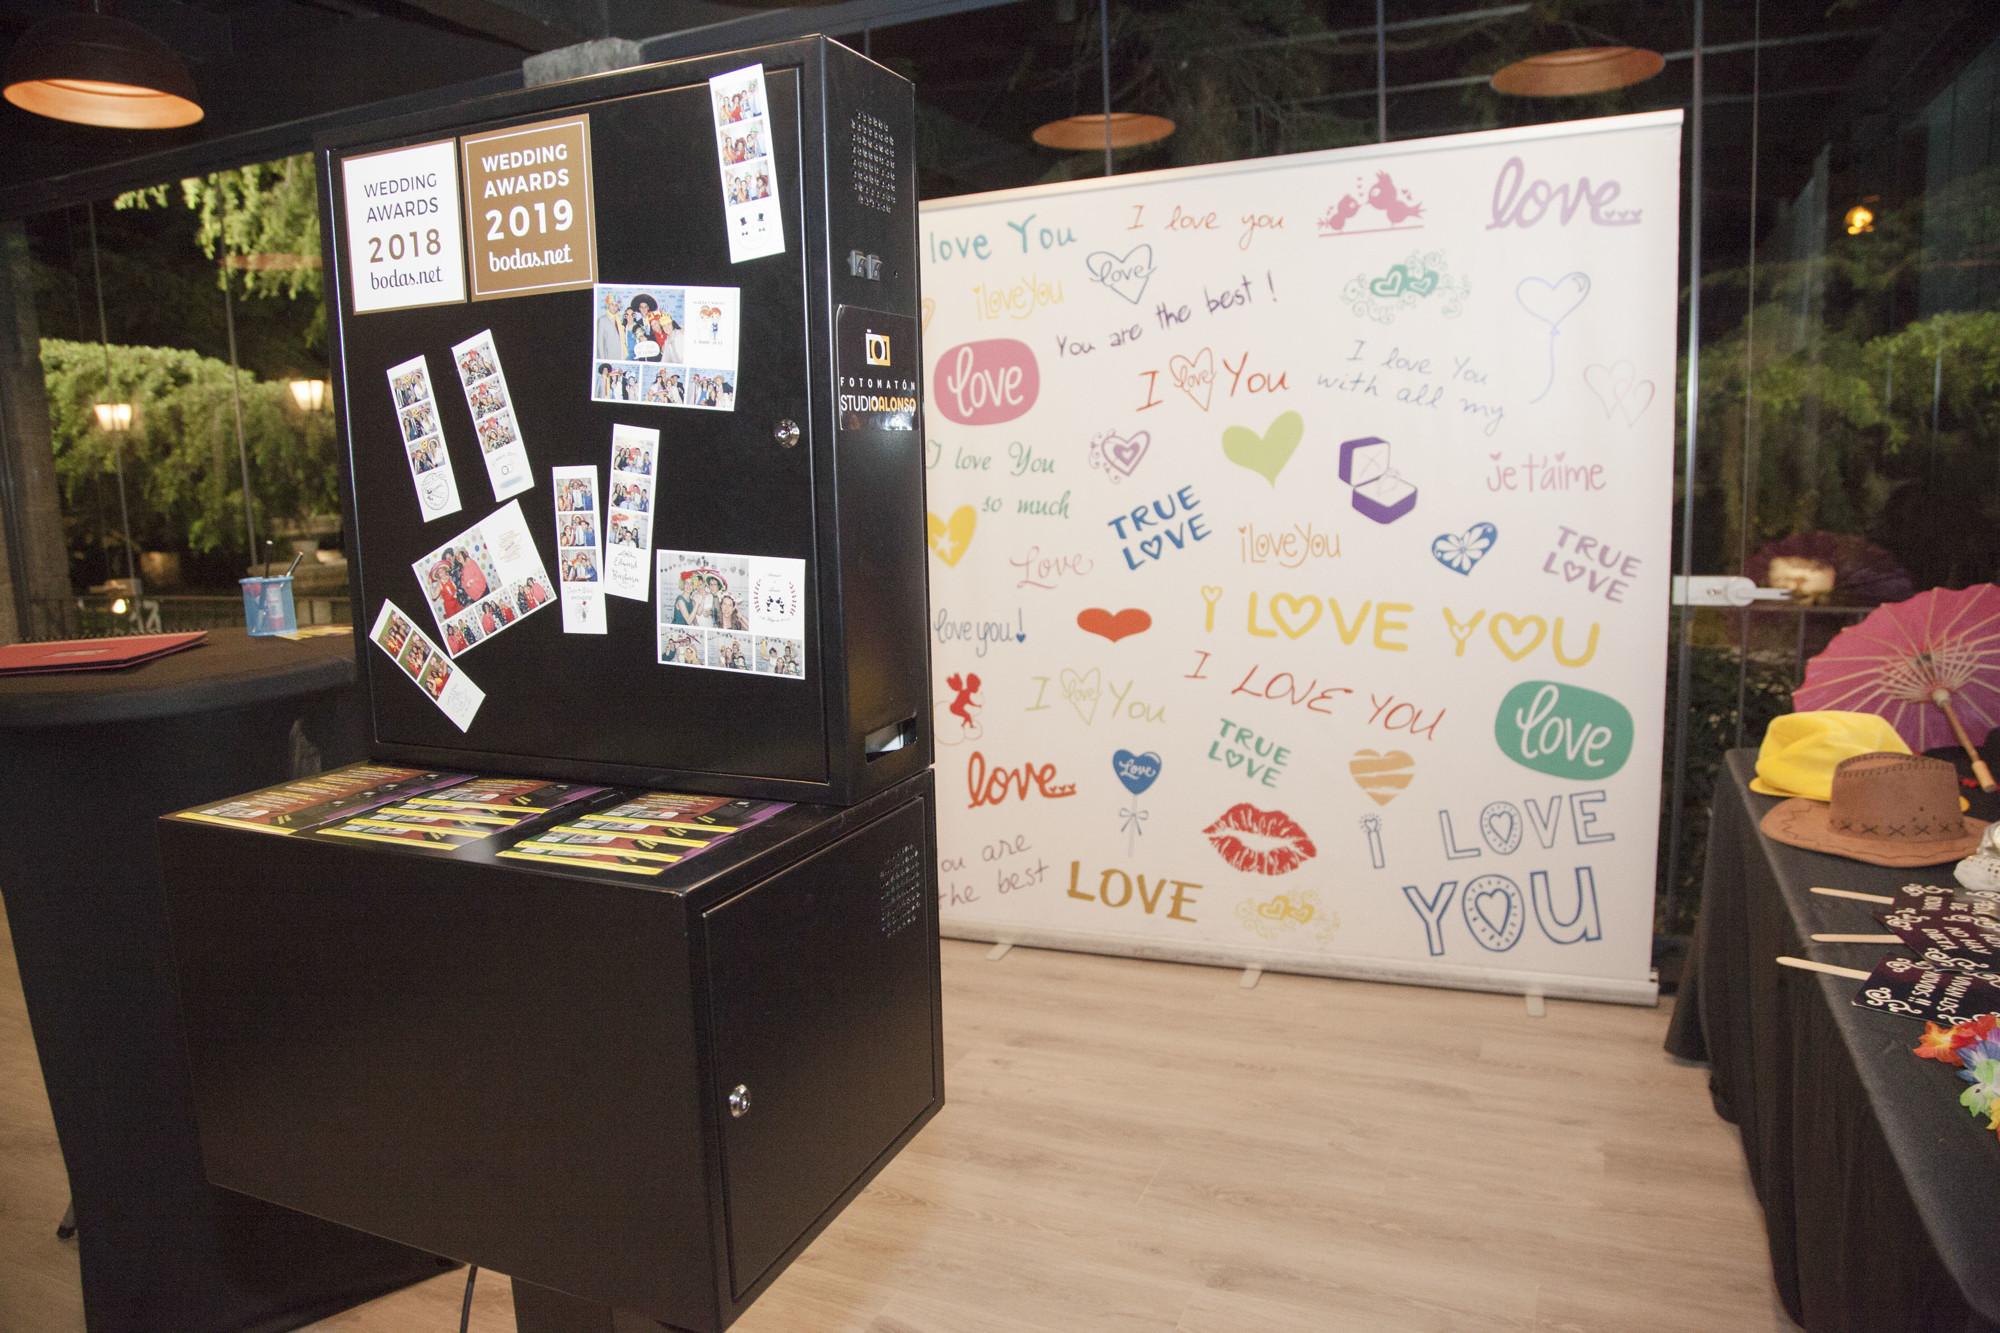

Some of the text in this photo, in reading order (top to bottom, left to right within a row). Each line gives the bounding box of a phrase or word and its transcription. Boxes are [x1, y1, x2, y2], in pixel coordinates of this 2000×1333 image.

[482, 143, 568, 172] WEDDING
[364, 173, 437, 198] WEDDING
[484, 168, 570, 198] AWARDS
[366, 197, 439, 223] AWARDS
[485, 199, 573, 241] 2019
[1127, 205, 1284, 250] I love you
[368, 228, 442, 263] 2018
[489, 244, 573, 272] bodas.net
[929, 213, 1078, 264] love You
[370, 266, 443, 290] bodas.net
[1056, 334, 1096, 358] You
[1110, 323, 1143, 348] are
[1156, 302, 1192, 330] the
[1203, 273, 1253, 314] best
[840, 376, 916, 391] FOTOMATÓN
[946, 346, 1024, 417] love
[1136, 370, 1163, 412] I
[1223, 351, 1291, 397] You
[1346, 339, 1489, 386] I love You
[1317, 373, 1505, 437] with all my
[955, 446, 992, 471] love
[1008, 441, 1056, 476] You
[1486, 452, 1518, 492] je
[982, 490, 1071, 519] so much
[1107, 485, 1201, 540] TRUE
[1121, 513, 1212, 571] LOVE
[1557, 525, 1642, 579] TRUE
[1009, 545, 1094, 590] Love
[1542, 551, 1631, 604] LOVE
[1247, 591, 1415, 652] LOVE
[1442, 606, 1601, 668] YOU
[1025, 676, 1051, 711] I
[1109, 680, 1166, 723] You
[1184, 650, 1446, 741] I LOVE YOU
[1219, 718, 1292, 767] TRUE
[1516, 684, 1612, 767] love
[1119, 759, 1156, 780] Love
[1208, 741, 1281, 788] LOVE
[1439, 790, 1615, 860] LOVE
[941, 834, 1032, 873] ou are
[998, 858, 1049, 894] best
[1067, 860, 1203, 923] LOVE
[1403, 866, 1601, 957] YOU
[1936, 996, 1960, 1014] LOS
